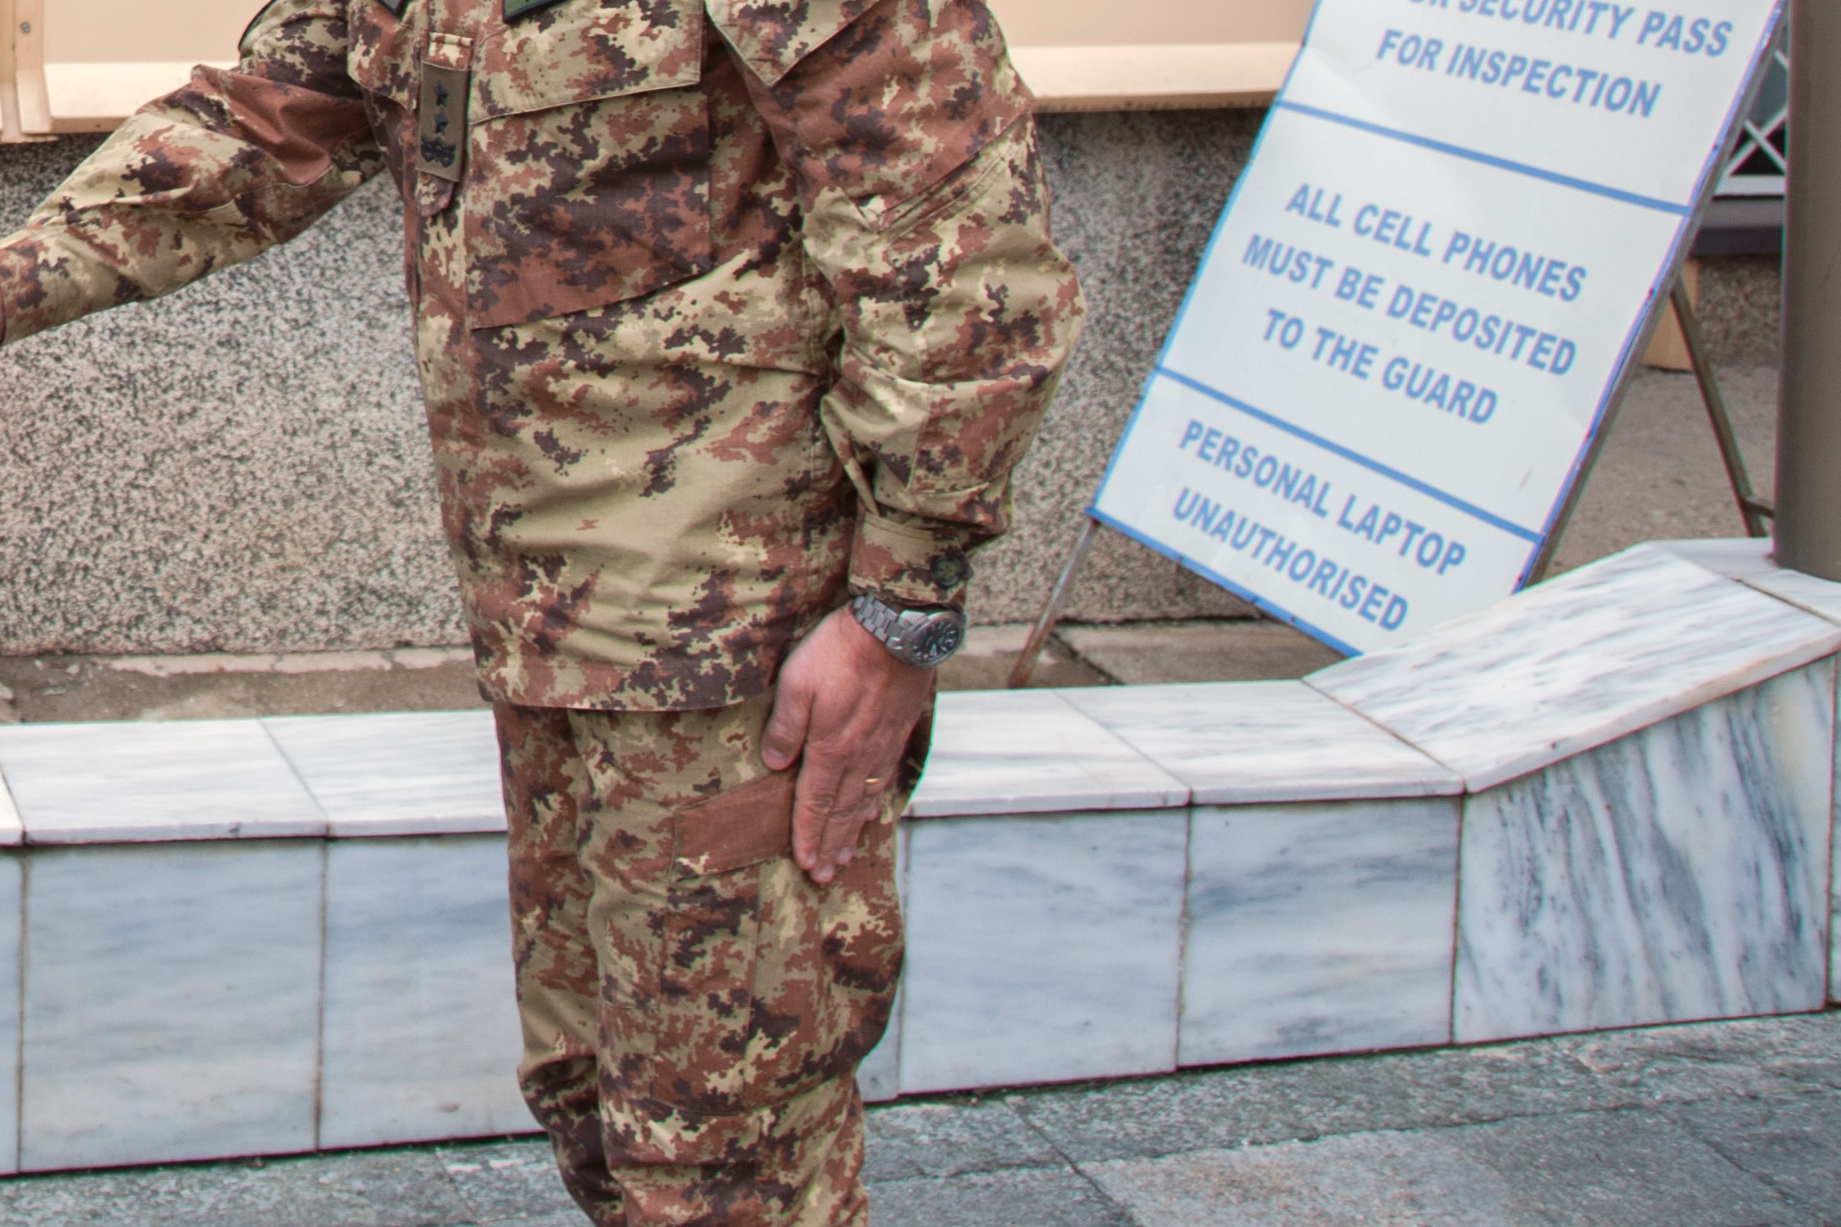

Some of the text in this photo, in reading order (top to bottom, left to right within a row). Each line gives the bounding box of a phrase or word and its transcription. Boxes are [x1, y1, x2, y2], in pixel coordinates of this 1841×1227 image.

[1376, 28, 1664, 119] FOR INSPECTION
[1637, 10, 1736, 58] PASS
[1286, 183, 1589, 303] ALL CELL PHONES
[1242, 234, 1579, 378] MUST BE DEPOSITED
[1263, 307, 1501, 426] TO THE GUARD
[1178, 418, 1469, 577] PERSONAL LAPTOP
[1172, 487, 1411, 633] UNAUTHORISED
